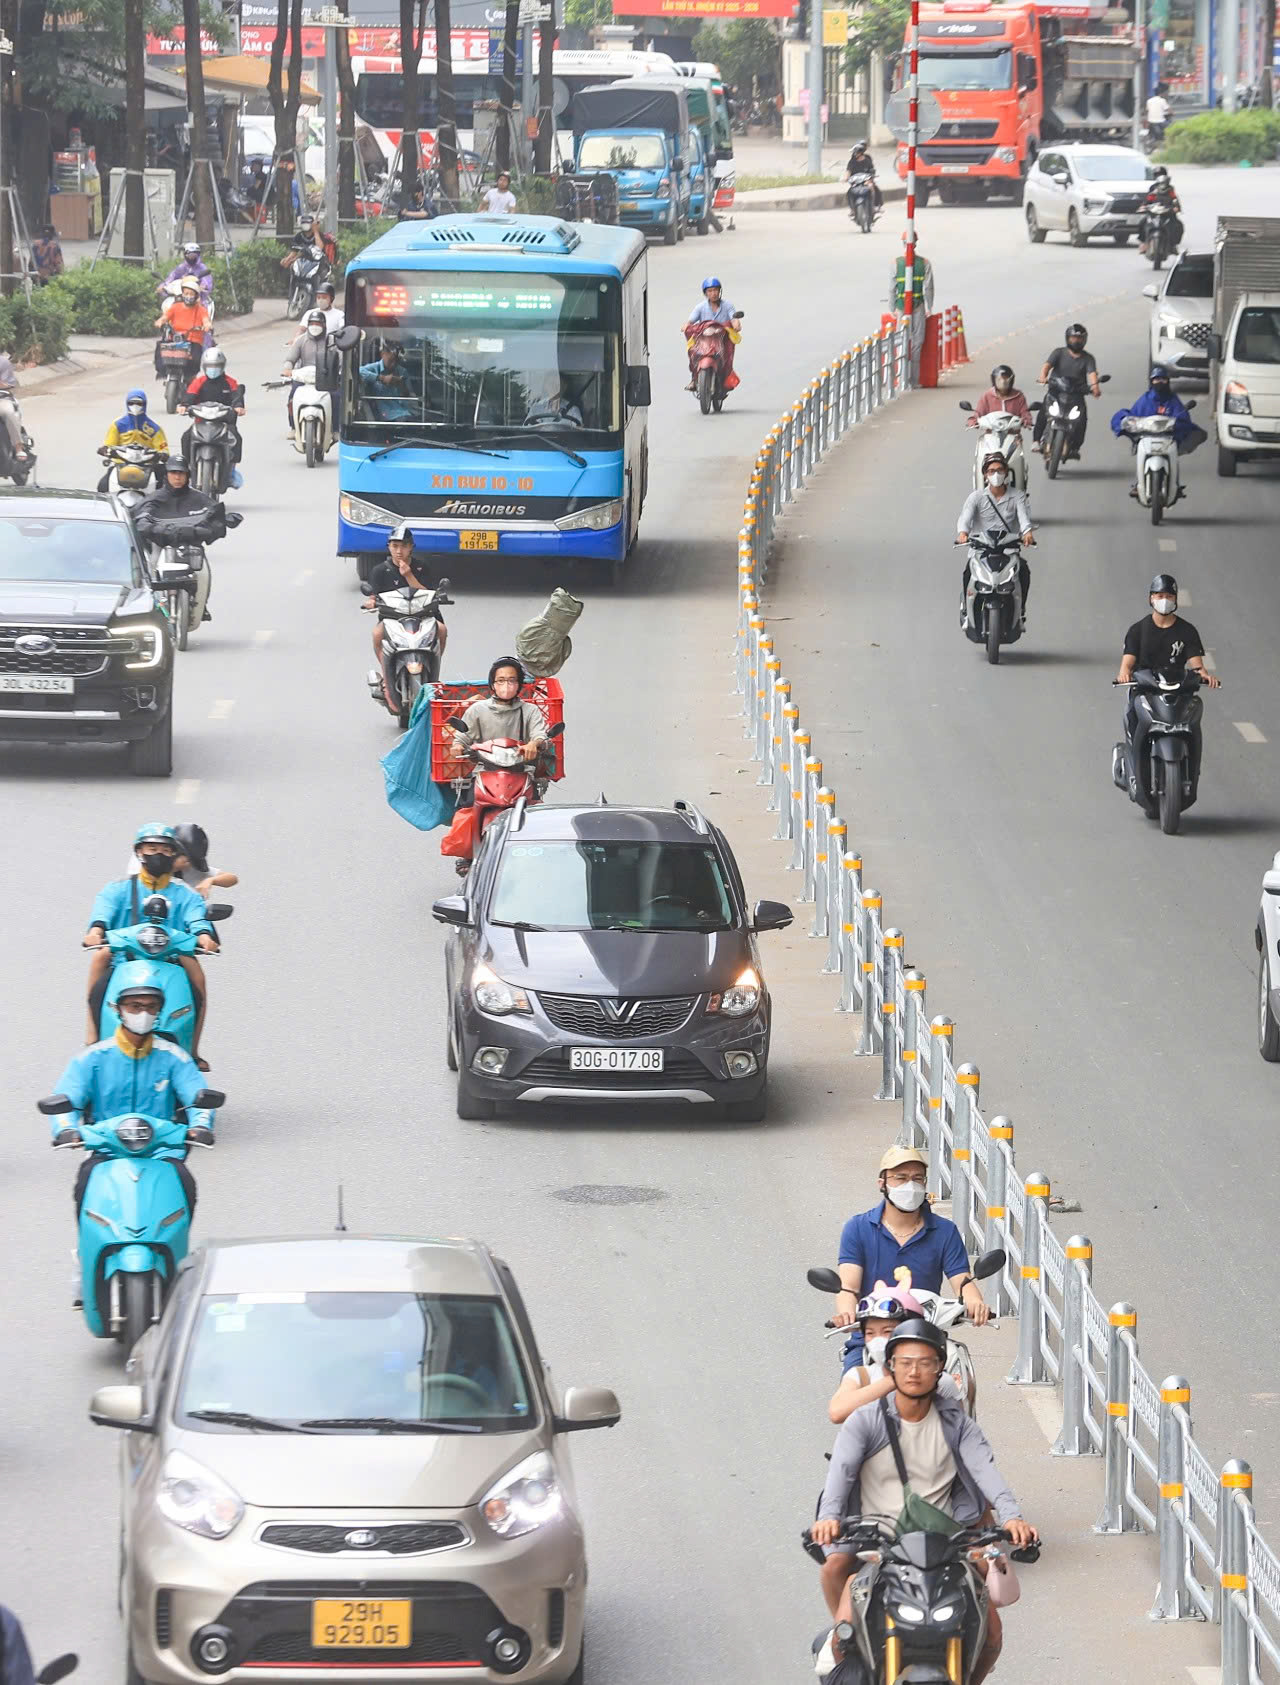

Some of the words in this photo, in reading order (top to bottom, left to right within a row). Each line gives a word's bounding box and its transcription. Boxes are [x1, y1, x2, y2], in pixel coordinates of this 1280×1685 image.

[458, 475, 487, 489] BUS
[492, 476, 507, 490] 10
[518, 476, 534, 491] 10
[434, 500, 527, 515] HANOIBUS
[471, 532, 487, 540] 29B
[464, 541, 494, 549] 191.56
[573, 1051, 661, 1068] 30G-017.08
[342, 1602, 384, 1621] 29H
[324, 1624, 399, 1643] 929.05
